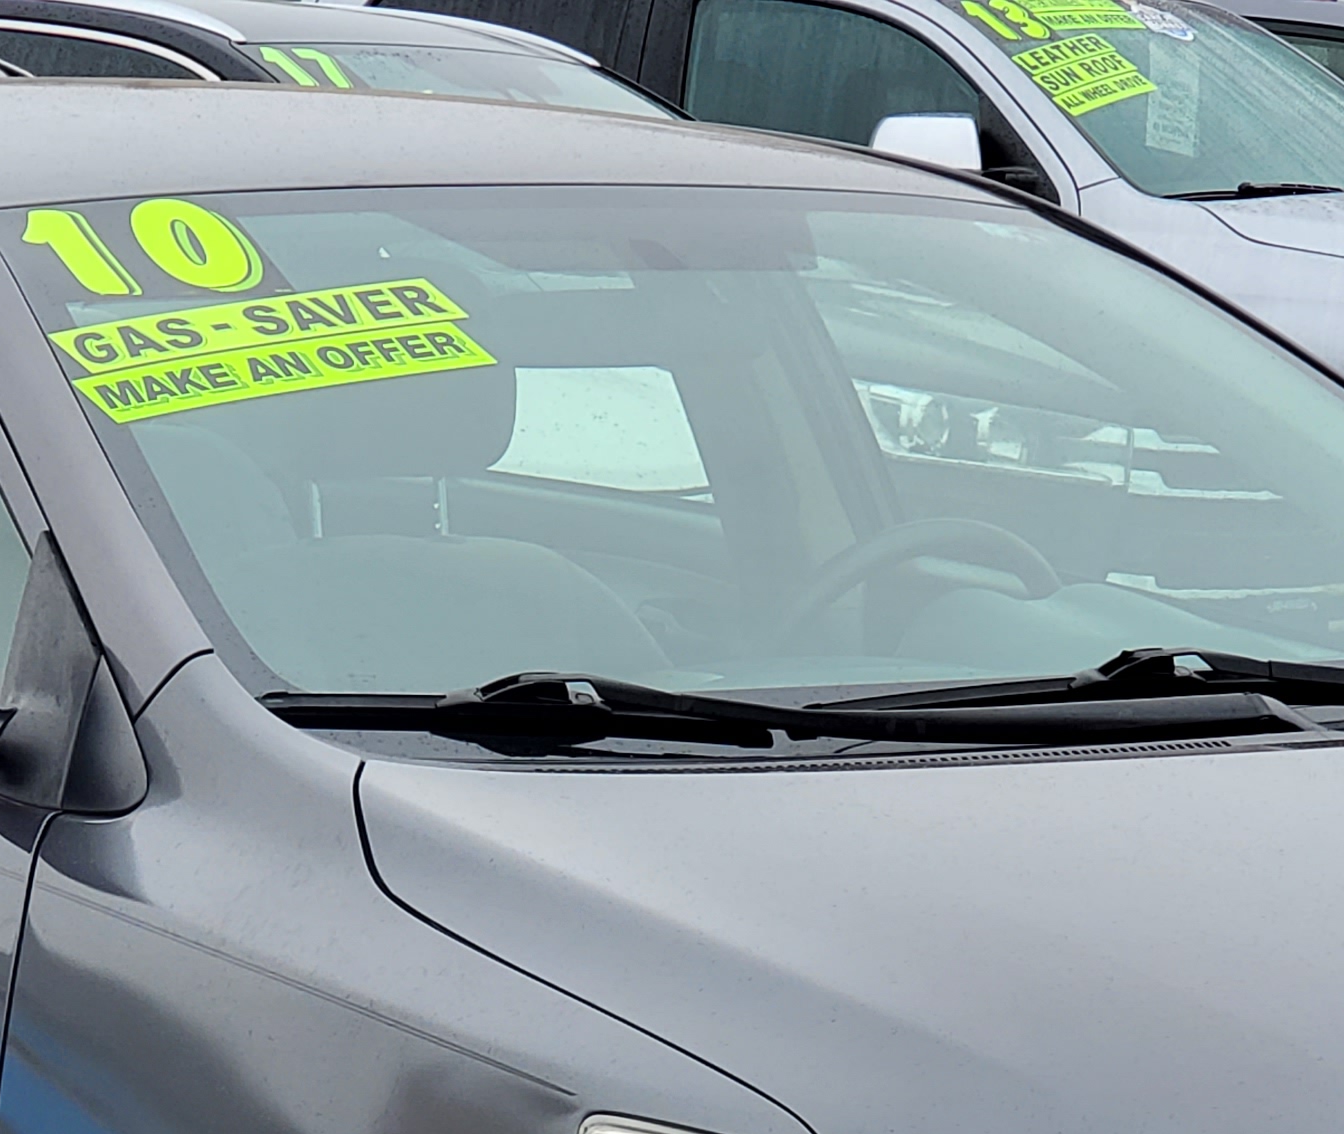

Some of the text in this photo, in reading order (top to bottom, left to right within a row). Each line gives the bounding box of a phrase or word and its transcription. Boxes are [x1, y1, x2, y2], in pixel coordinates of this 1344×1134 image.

[960, 0, 1050, 40] 13
[259, 46, 355, 89] 17
[1017, 36, 1109, 71] LEATHER
[1039, 54, 1131, 92] SUN ROOF
[1059, 74, 1148, 110] ALL WHEEL DRIVE
[21, 197, 265, 297] 10
[91, 330, 466, 411] MAKE AN OFFER
